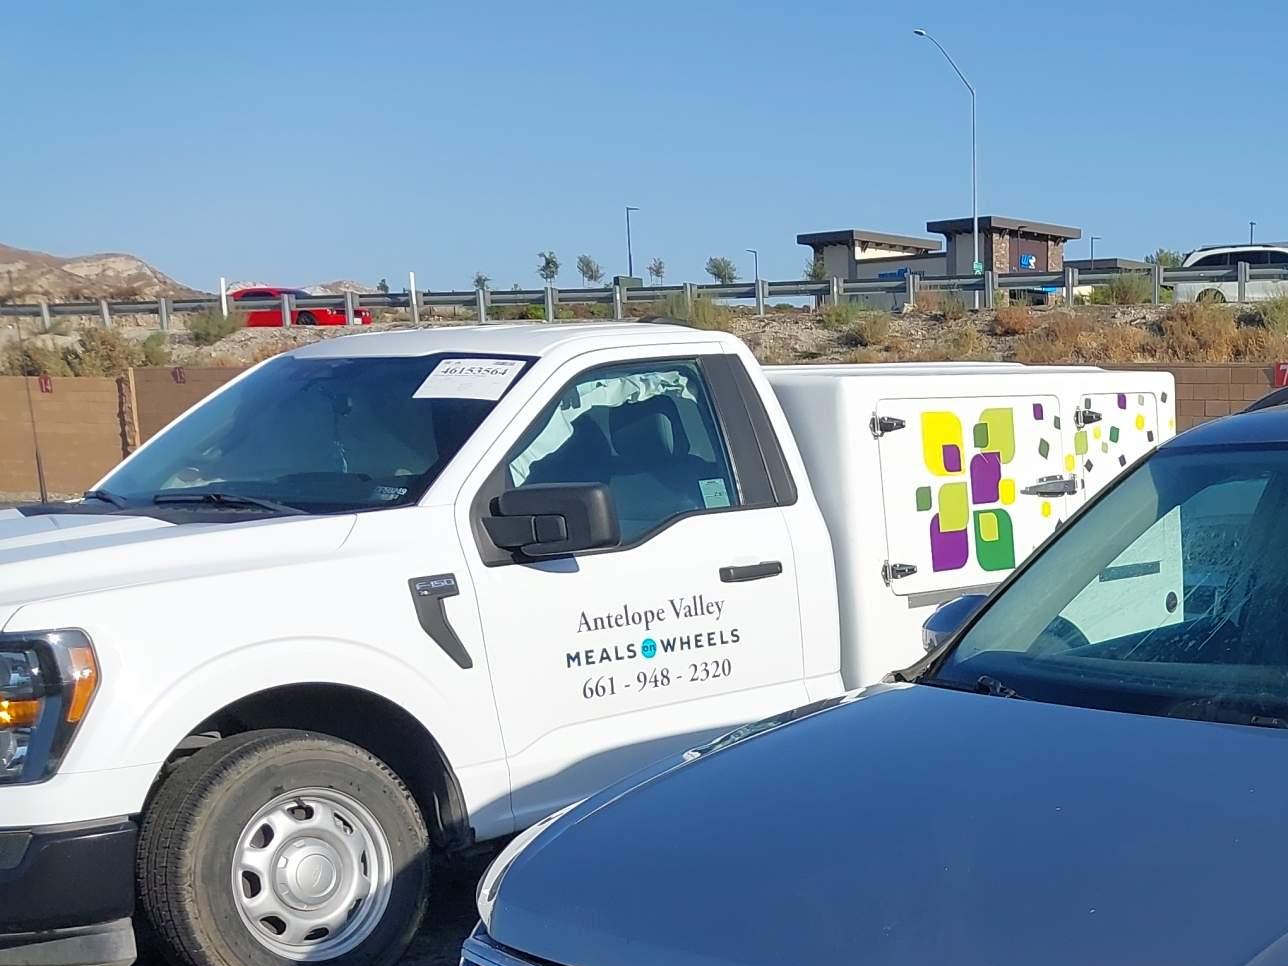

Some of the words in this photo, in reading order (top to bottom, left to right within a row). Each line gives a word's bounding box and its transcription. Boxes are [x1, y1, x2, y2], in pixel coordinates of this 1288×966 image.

[441, 367, 509, 376] 46153564
[415, 578, 455, 590] F-150
[576, 604, 666, 633] Antelope
[668, 594, 725, 621] Valley
[566, 643, 637, 668] MEALS
[642, 644, 657, 652] on
[660, 628, 741, 653] WHEELS
[582, 676, 617, 699] 661
[636, 667, 671, 692] 948
[688, 658, 732, 682] 2320
